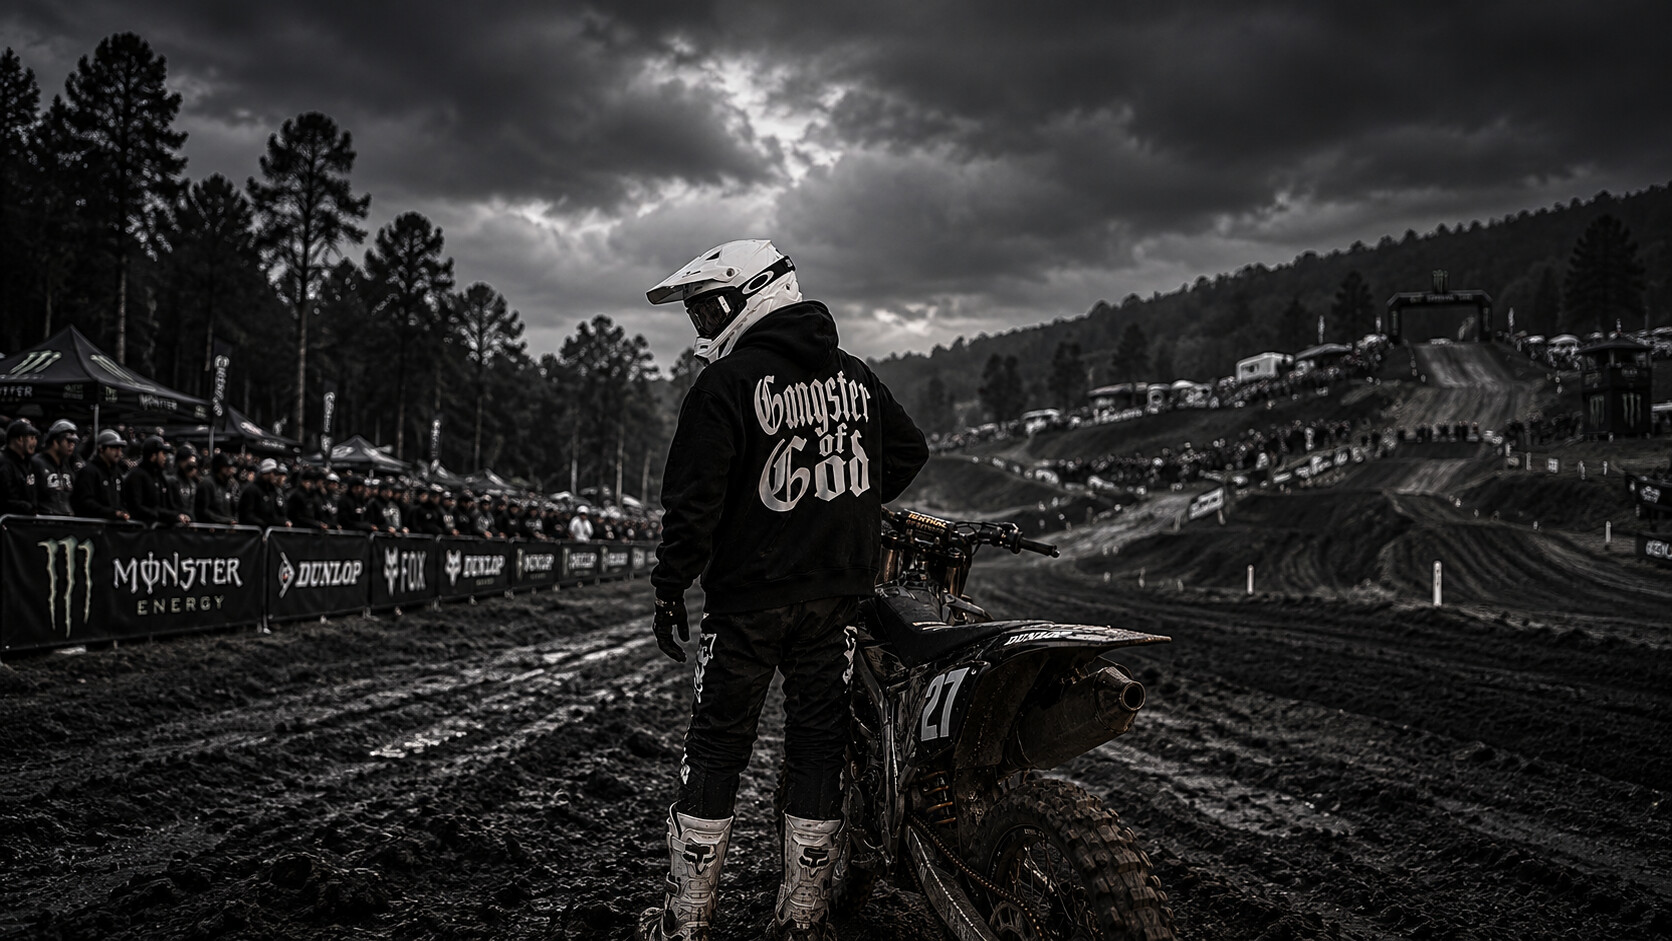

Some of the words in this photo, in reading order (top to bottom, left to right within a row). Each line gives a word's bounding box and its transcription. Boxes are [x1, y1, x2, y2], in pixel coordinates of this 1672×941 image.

[754, 370, 871, 436] Gangster
[817, 423, 848, 457] of
[758, 429, 871, 512] God
[112, 551, 243, 595] MONSTER
[294, 559, 364, 588] DUNLOP
[401, 551, 427, 593] FOX
[136, 595, 225, 616] ENERGY
[920, 666, 970, 742] 27
